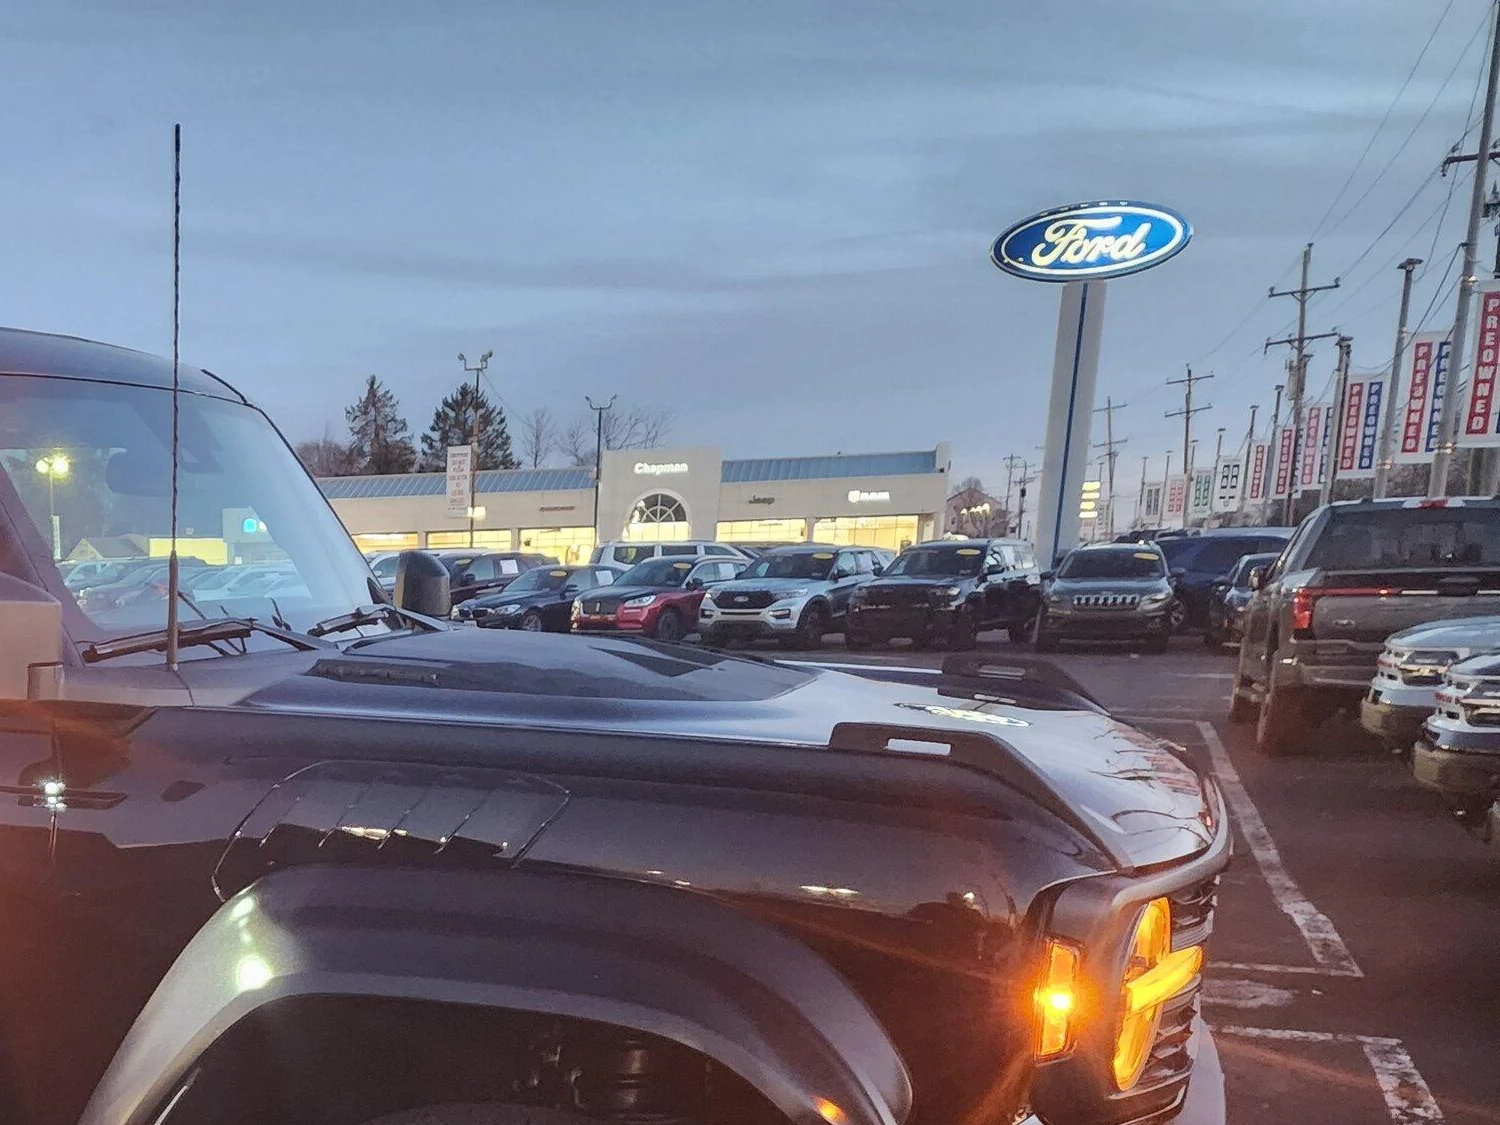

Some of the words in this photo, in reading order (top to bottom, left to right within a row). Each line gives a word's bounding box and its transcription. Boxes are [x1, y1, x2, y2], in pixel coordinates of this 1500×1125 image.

[1031, 216, 1152, 267] Ford
[1470, 298, 1500, 431] PREOWNED
[634, 462, 688, 475] Chapman
[748, 495, 775, 505] Jeep
